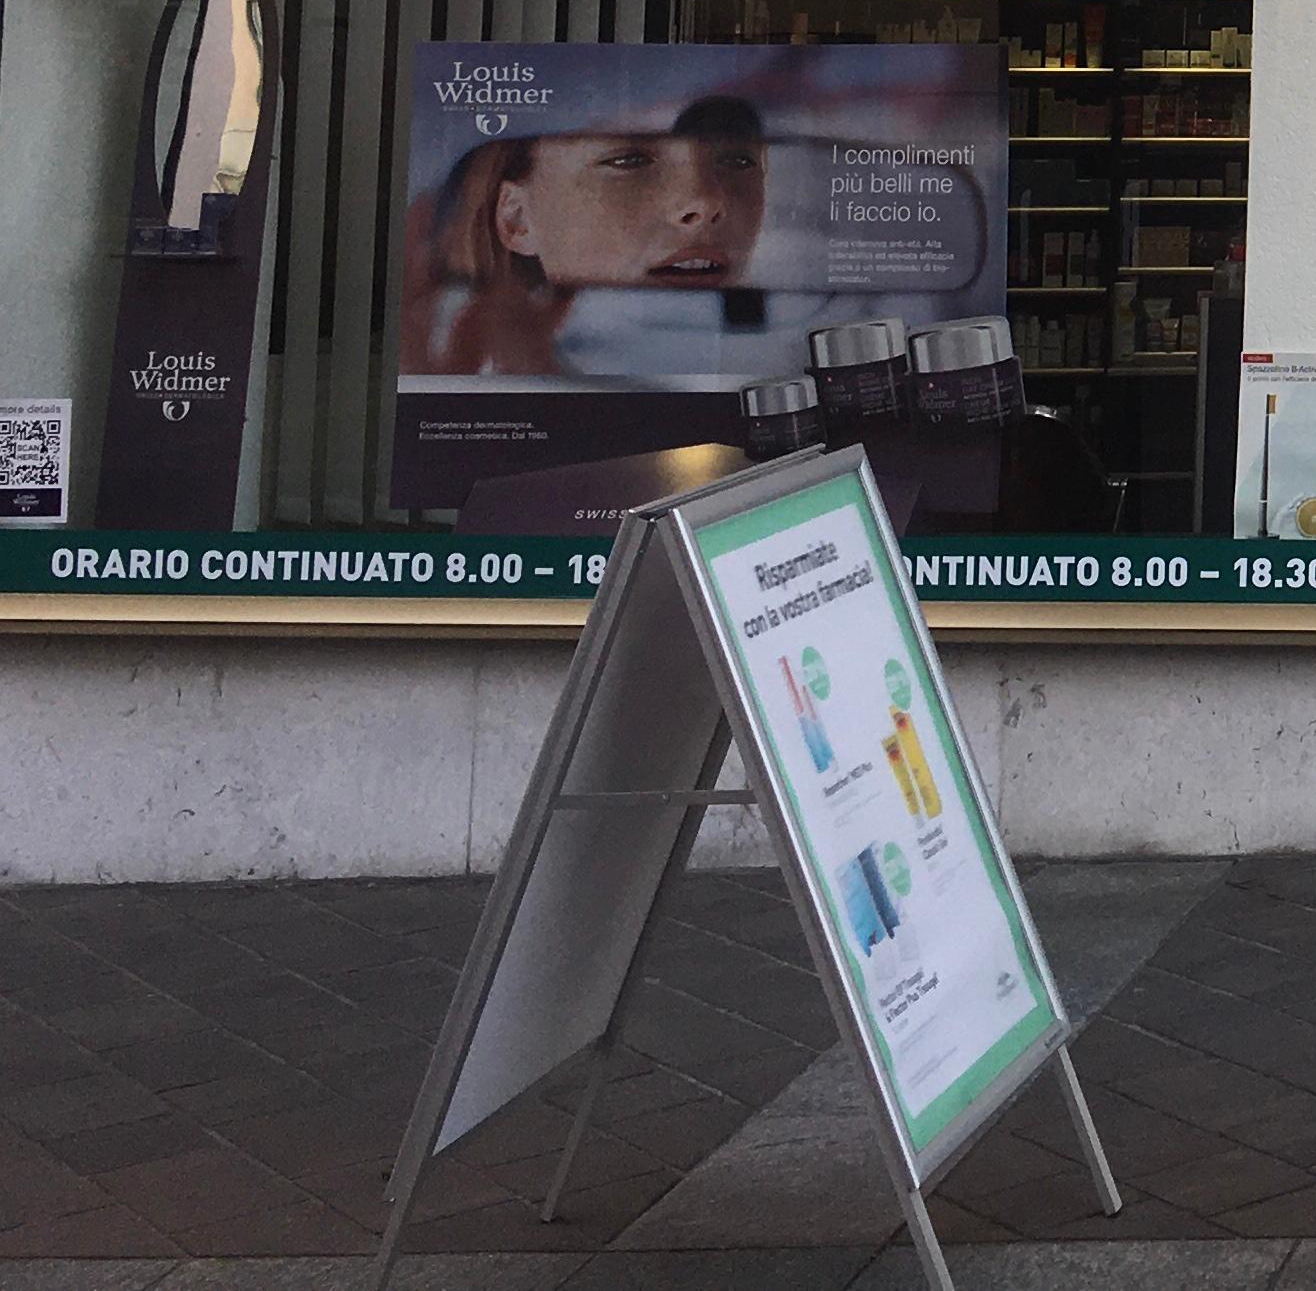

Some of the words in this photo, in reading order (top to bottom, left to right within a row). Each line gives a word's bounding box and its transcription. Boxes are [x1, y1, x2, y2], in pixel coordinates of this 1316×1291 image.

[453, 61, 536, 84] Louis
[433, 81, 554, 106] Widmer
[831, 145, 839, 166] I
[844, 144, 976, 171] complimenti
[830, 173, 864, 199] più
[869, 172, 913, 194] belli
[919, 178, 953, 194] me
[829, 201, 841, 222] li
[846, 200, 912, 222] faccio
[917, 200, 942, 223] io.
[146, 350, 217, 371] Louis
[129, 370, 231, 392] Widmer
[27, 404, 62, 414] details
[17, 444, 40, 452] SCAN
[17, 453, 39, 461] HERE
[51, 548, 190, 580] ORARIO
[201, 549, 434, 583] CONTINUATO
[445, 552, 523, 584] 8.00
[568, 554, 607, 585] 18
[754, 540, 840, 592] Risparmiate
[903, 554, 1100, 587] NTINUATO
[1110, 556, 1188, 588] 8.00
[743, 614, 769, 639] con
[764, 605, 781, 629] la
[779, 589, 821, 622] vostra
